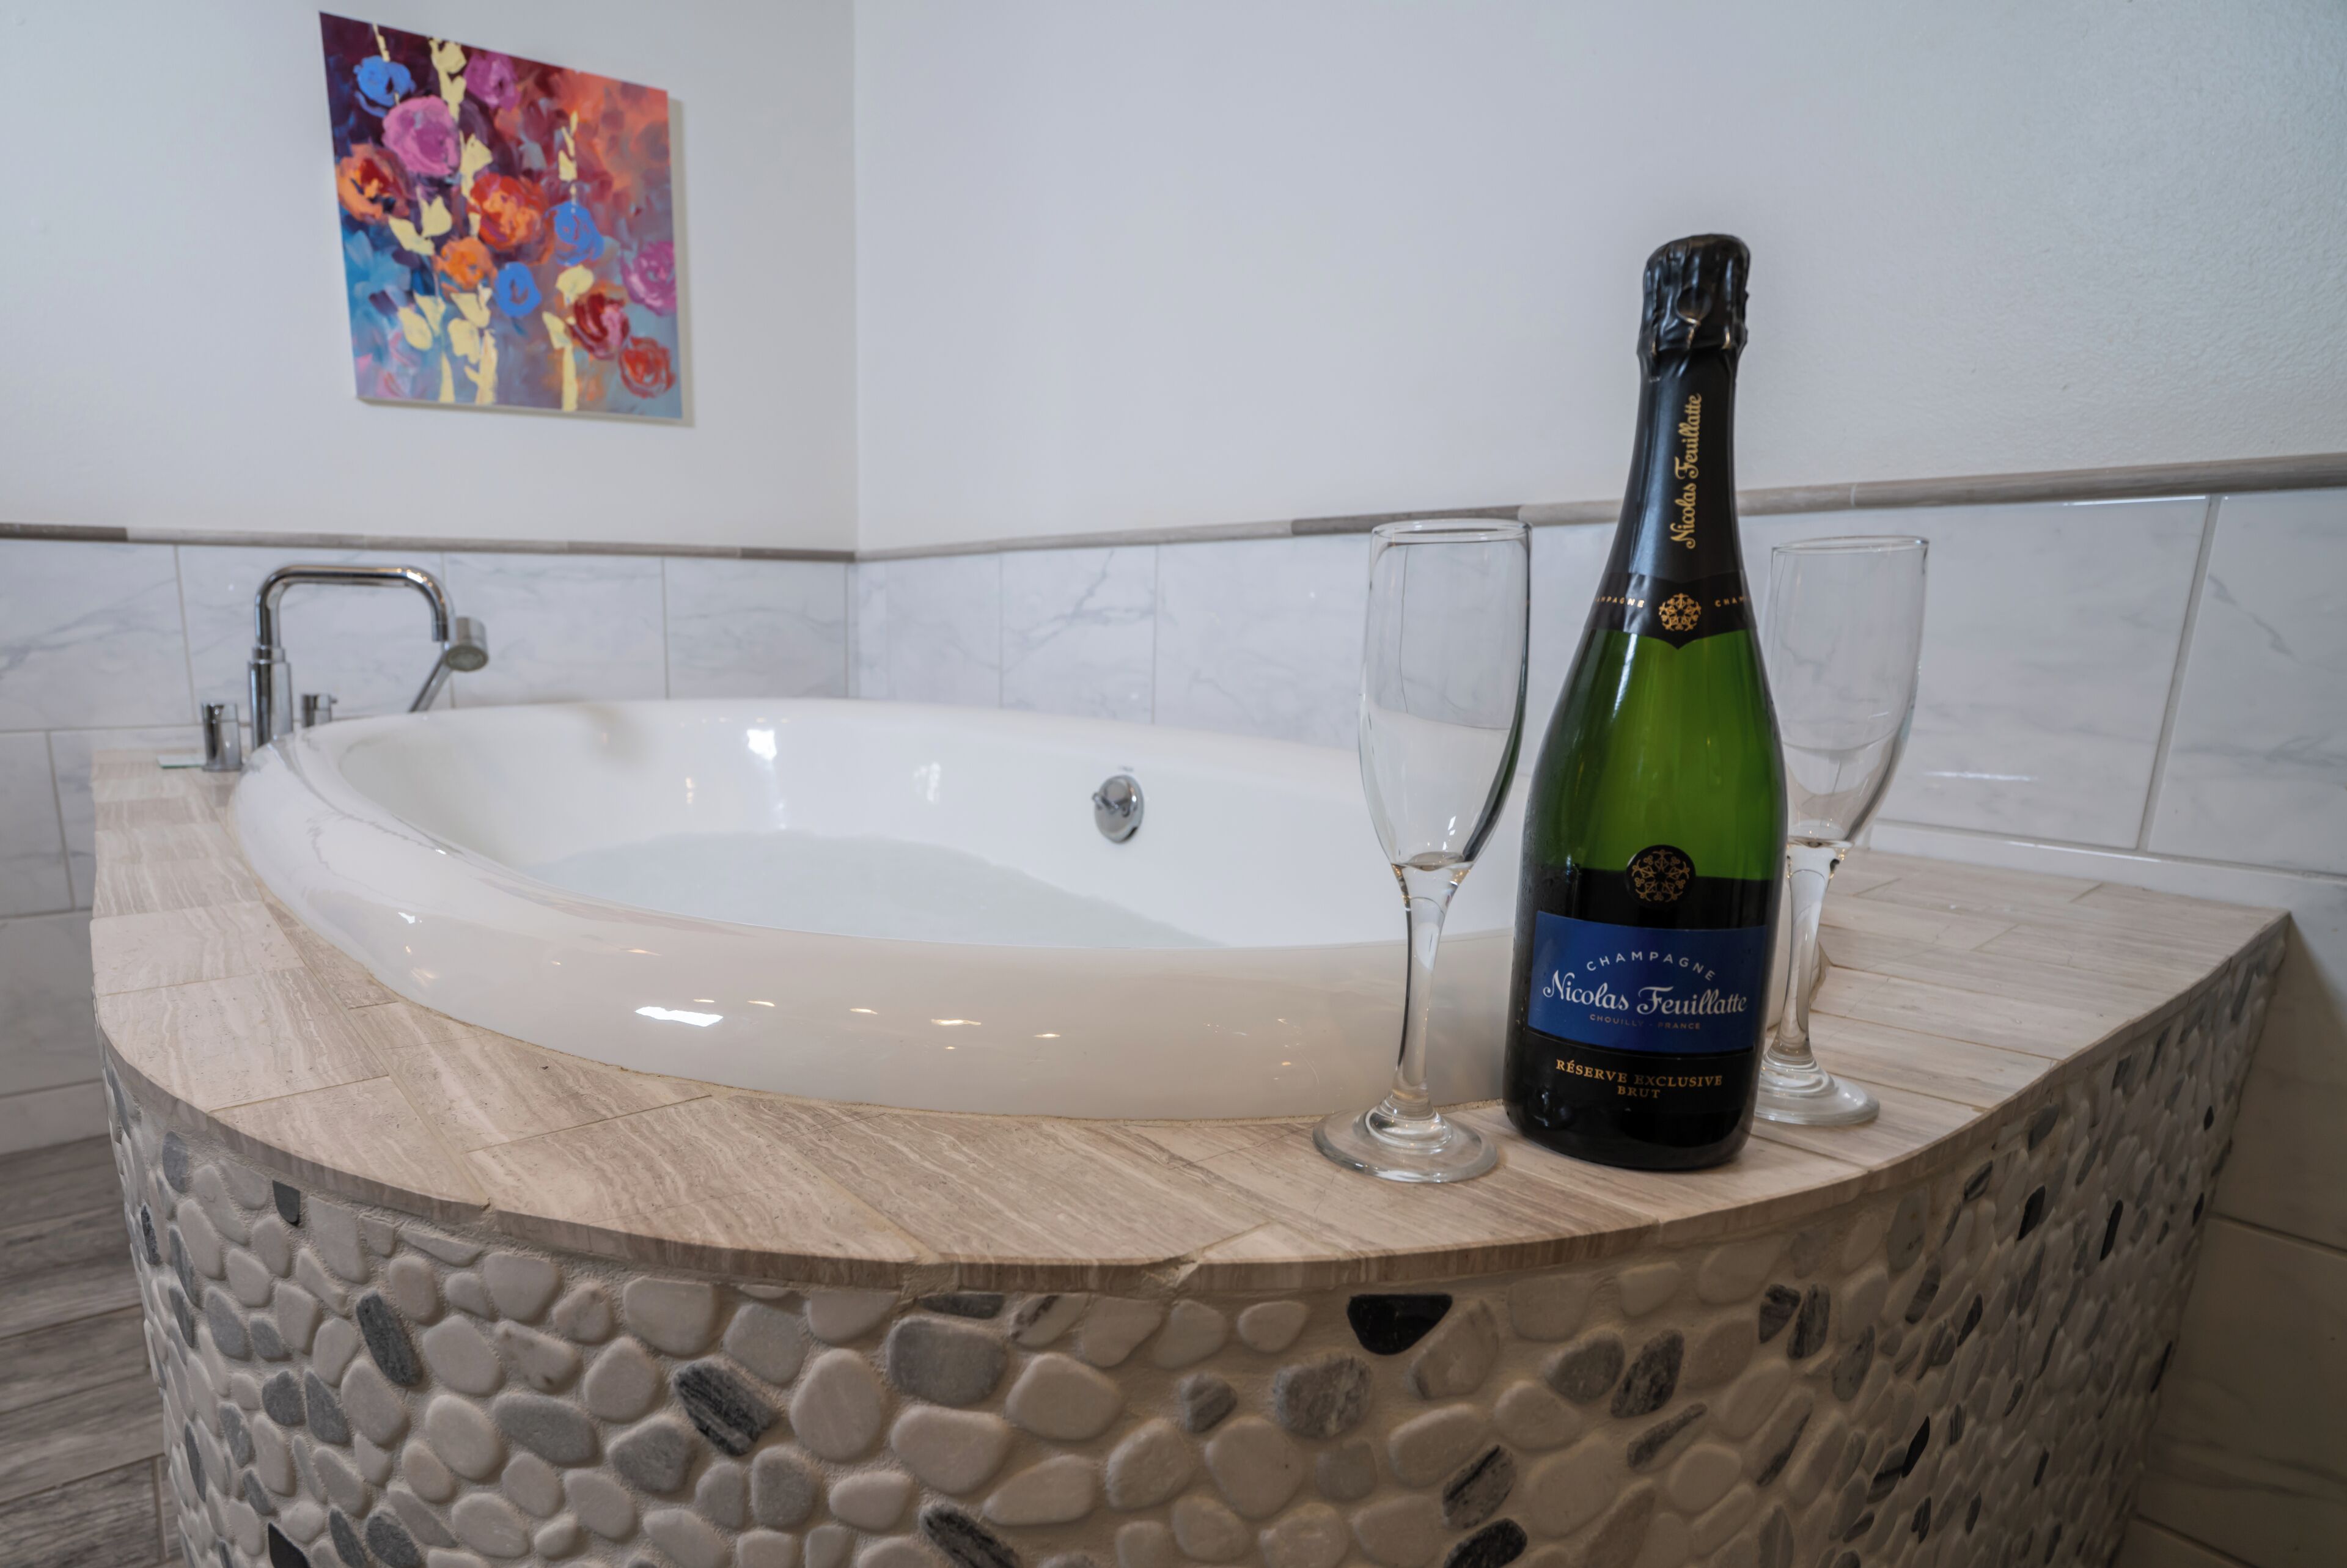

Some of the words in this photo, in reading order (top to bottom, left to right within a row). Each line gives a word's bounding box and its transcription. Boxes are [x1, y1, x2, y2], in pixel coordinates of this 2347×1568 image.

[1675, 393, 1702, 480] Feuillatte
[1670, 482, 1697, 549] Nicolas
[1587, 951, 1716, 981] CHAMPAGNE
[1543, 970, 1629, 1011] Nicolas
[1637, 986, 1747, 1016] Feuillatte
[1590, 1014, 1644, 1027] CHOUILLY
[1555, 1059, 1627, 1083] RÉSERVE
[1634, 1075, 1722, 1087] EXCLUSIVE
[1617, 1085, 1661, 1099] BRUT
